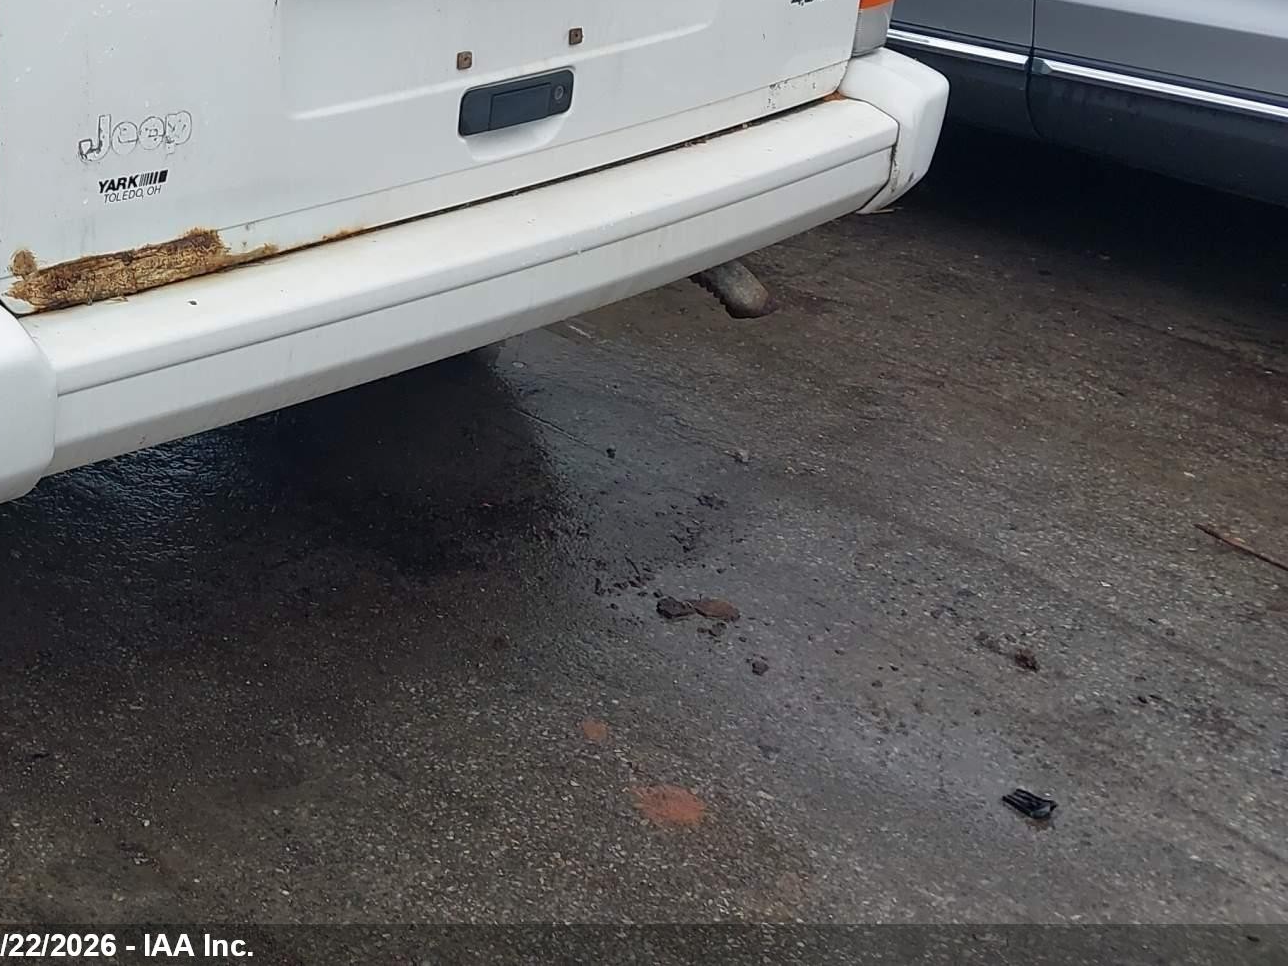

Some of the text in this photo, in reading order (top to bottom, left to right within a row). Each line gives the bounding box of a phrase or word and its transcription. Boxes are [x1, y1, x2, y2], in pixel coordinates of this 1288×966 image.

[78, 109, 192, 164] Jeep
[98, 173, 140, 194] YARK
[103, 184, 162, 204] TOLEDO, OH
